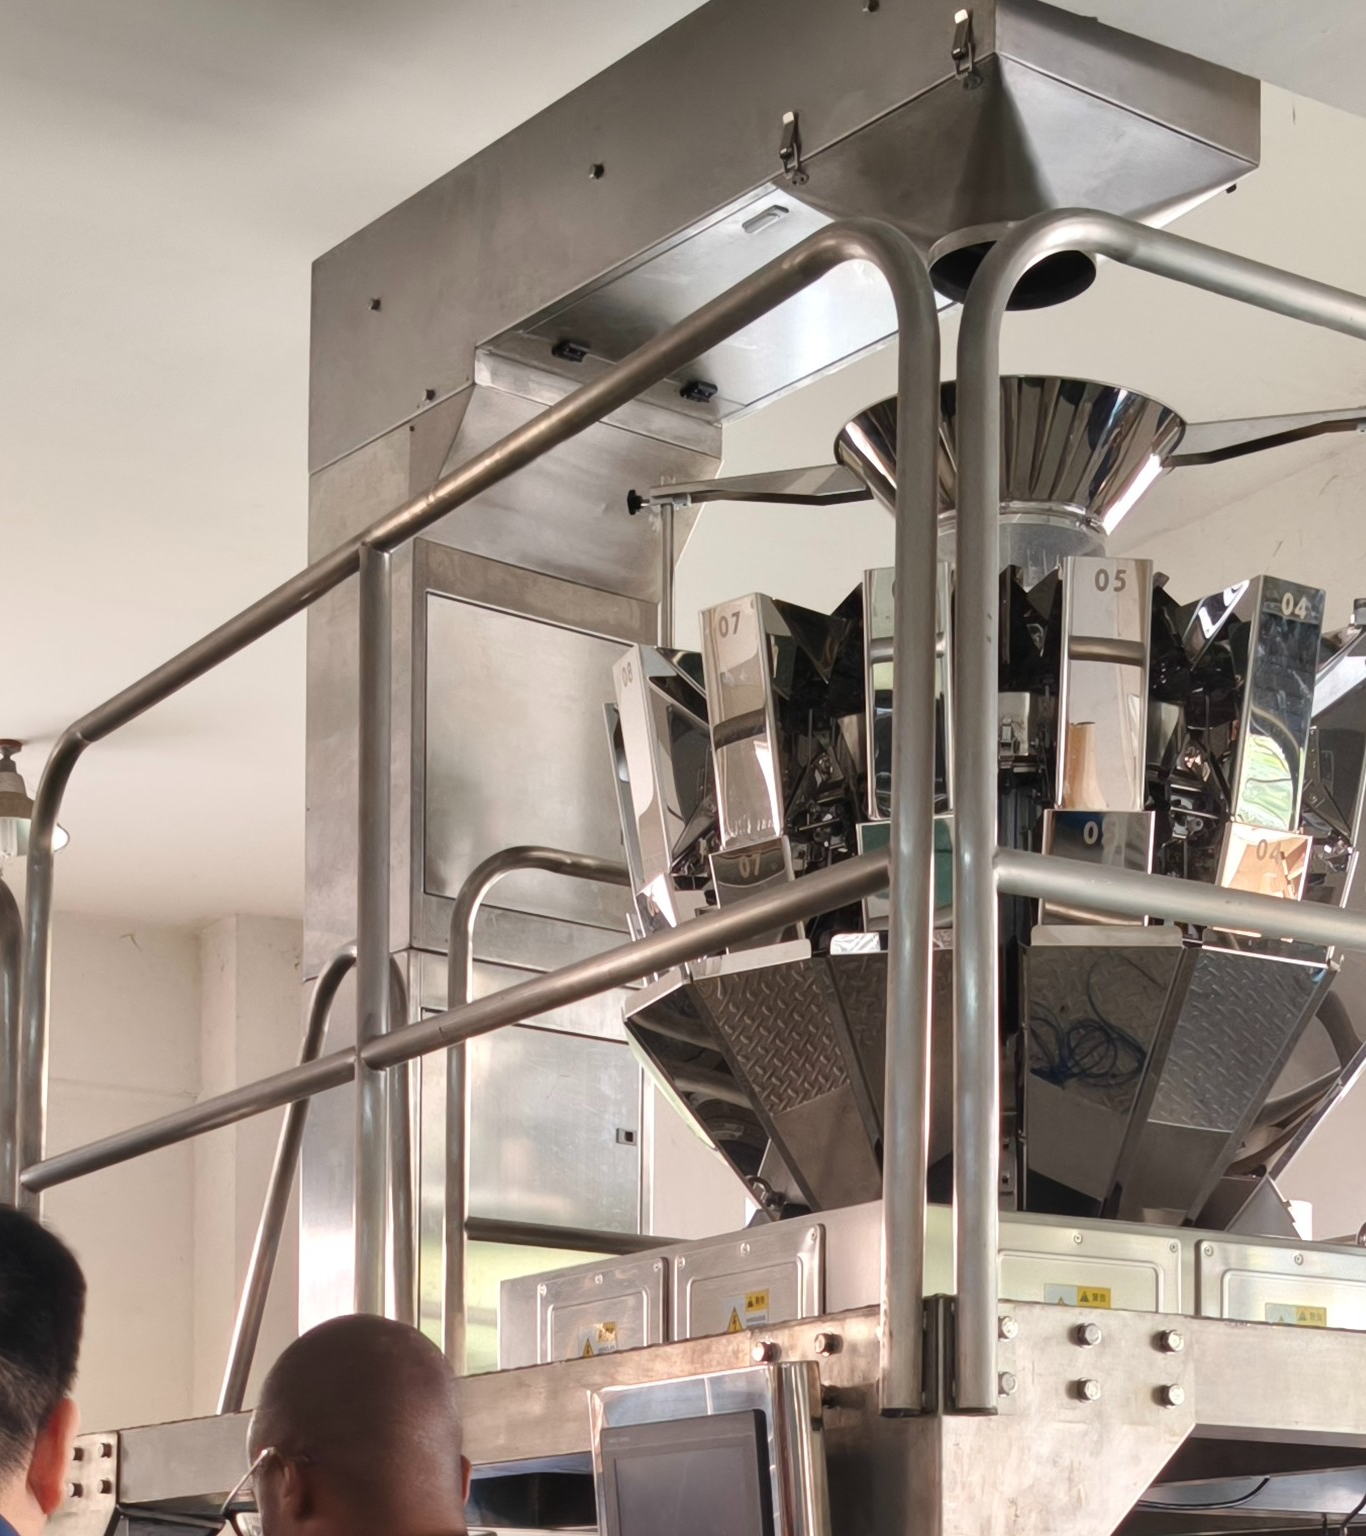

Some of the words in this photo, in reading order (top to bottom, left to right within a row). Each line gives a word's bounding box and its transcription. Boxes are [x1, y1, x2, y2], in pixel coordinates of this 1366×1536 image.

[1095, 568, 1127, 592] 05
[1281, 592, 1307, 620] 04
[718, 610, 741, 638] 07
[621, 661, 633, 688] 08
[738, 851, 762, 879] 07
